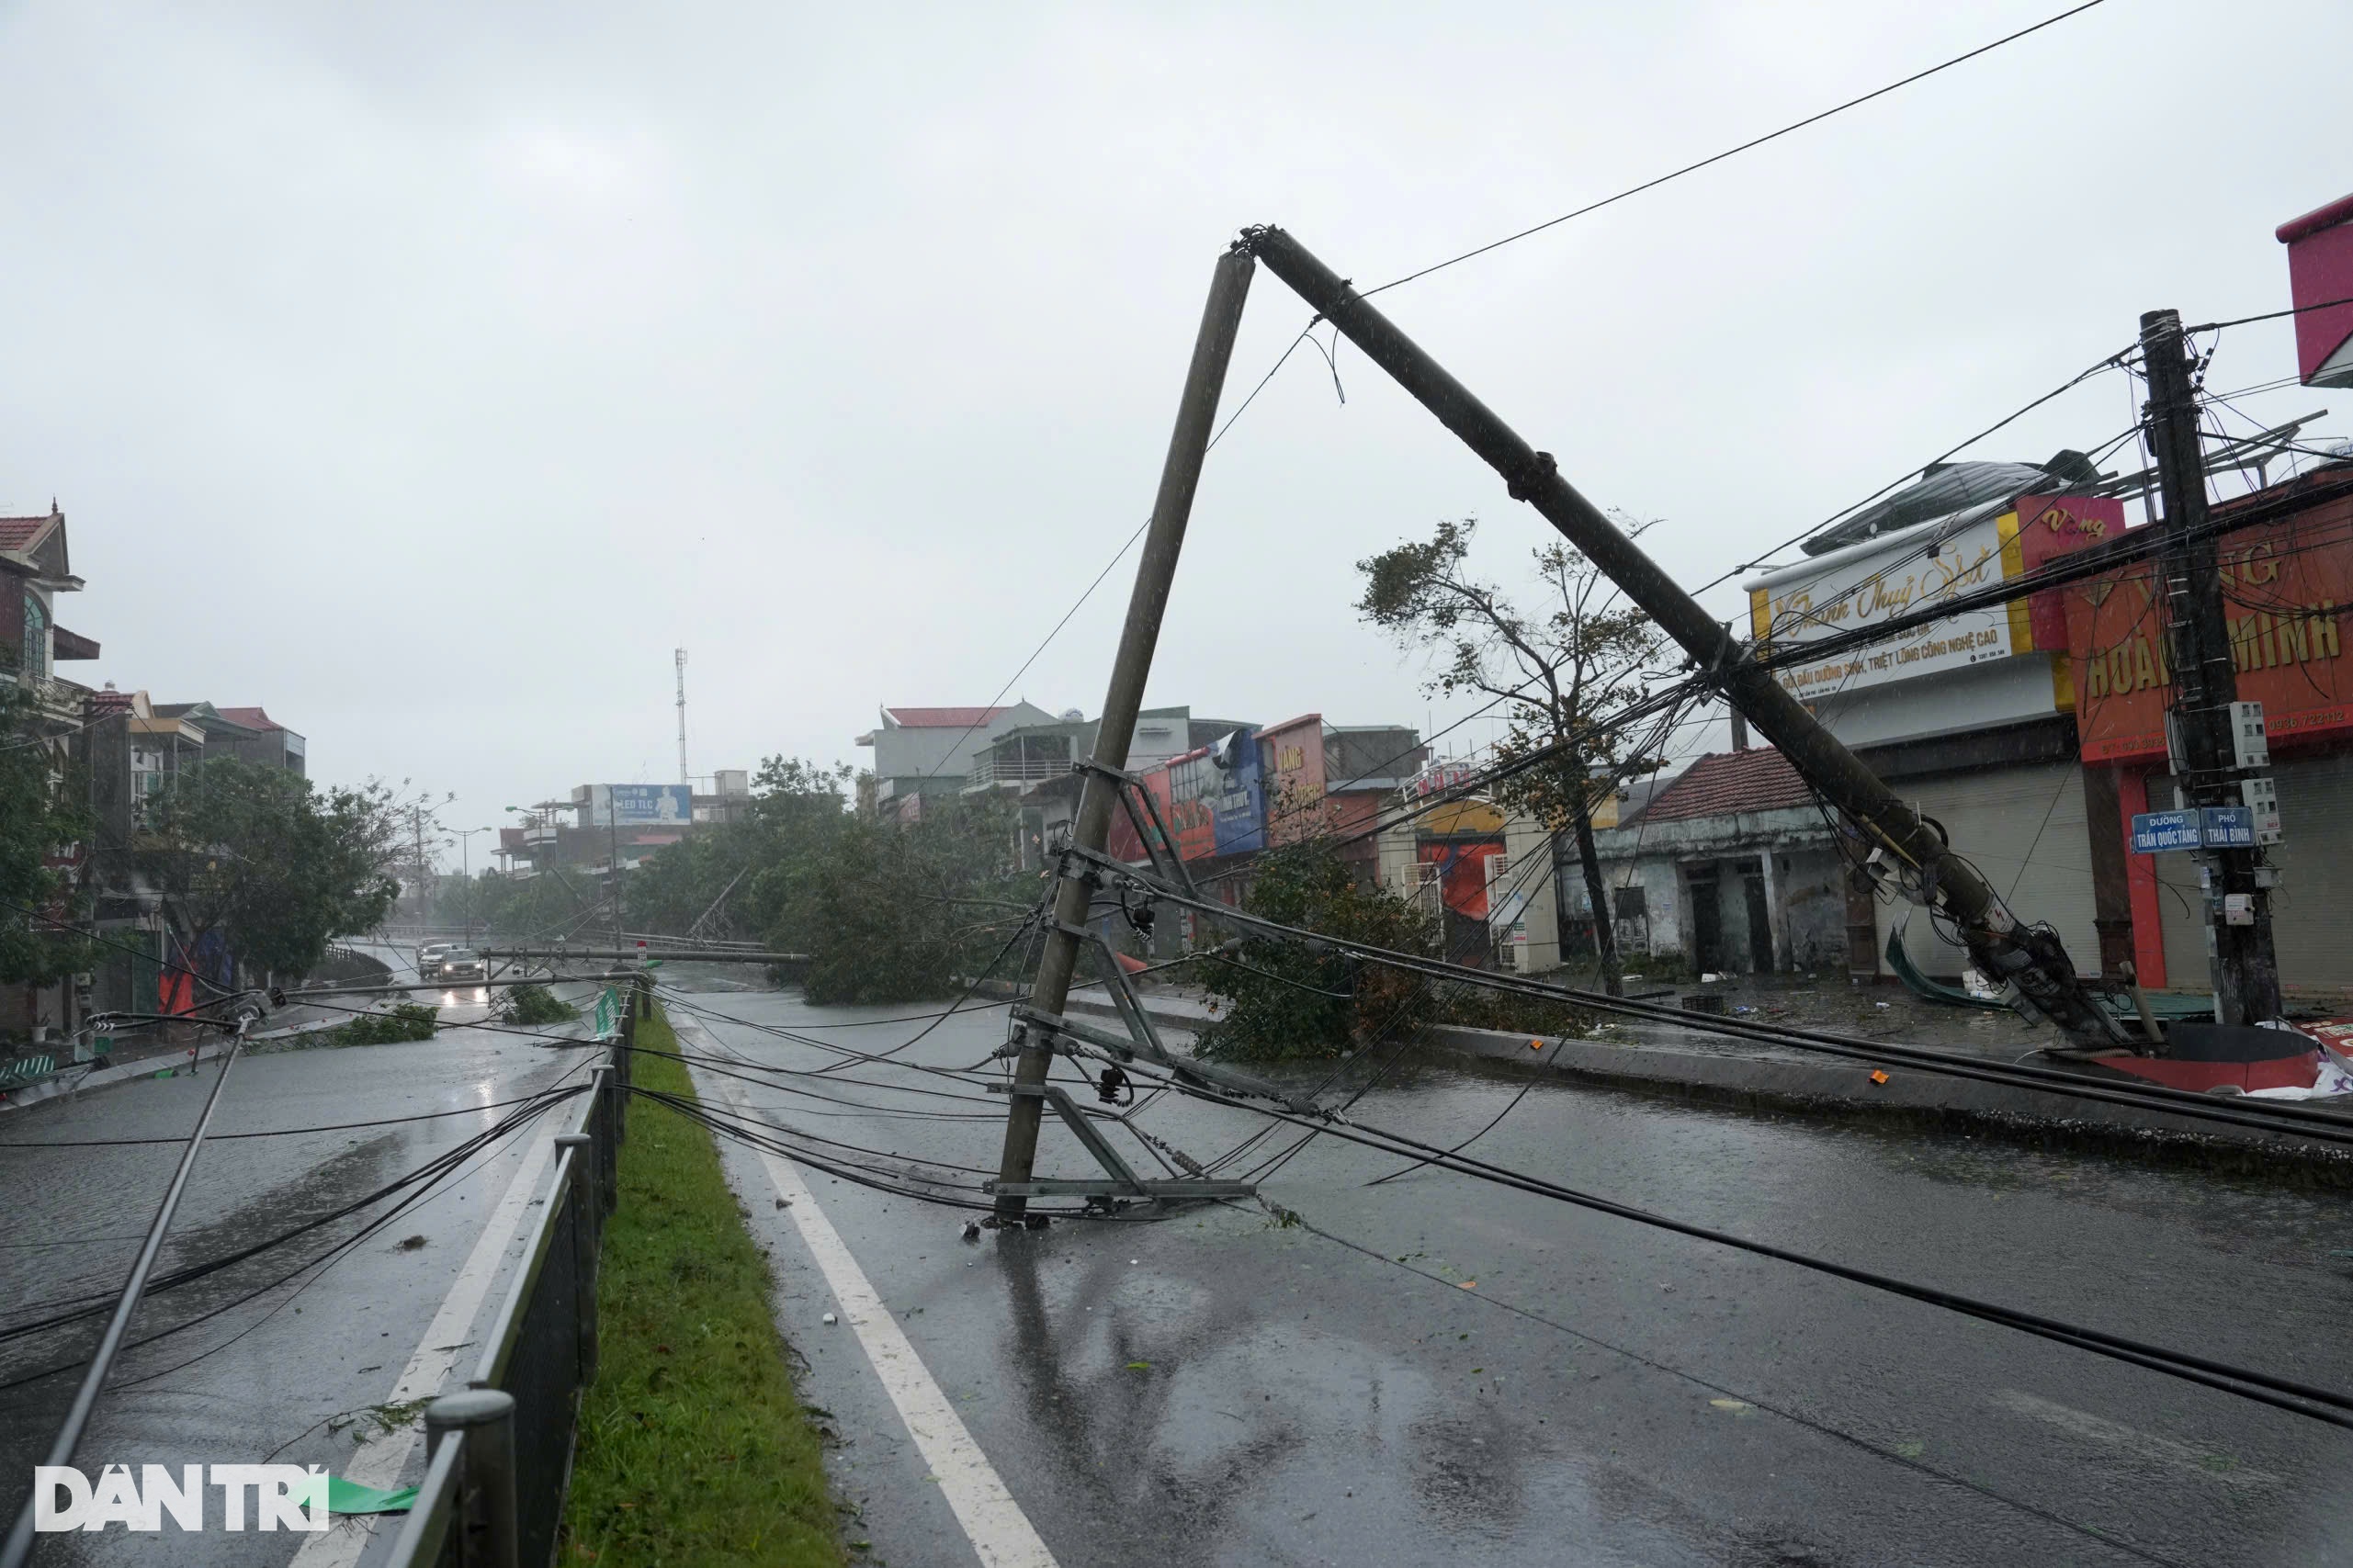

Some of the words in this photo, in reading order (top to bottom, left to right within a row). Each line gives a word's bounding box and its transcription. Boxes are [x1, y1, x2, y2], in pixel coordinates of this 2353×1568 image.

[1868, 650, 1893, 672] TRIỆT
[1921, 641, 1947, 660] CÔNG
[1949, 631, 1974, 653] NGHỆ
[1977, 629, 1998, 646] CAO
[2149, 815, 2184, 827] ĐƯỜNG
[2218, 810, 2236, 823] PHỐ
[2157, 827, 2178, 848] QUỐC
[2178, 825, 2198, 844] TẢNG
[2208, 826, 2228, 843] THÁI
[2230, 826, 2250, 842] BÌNH
